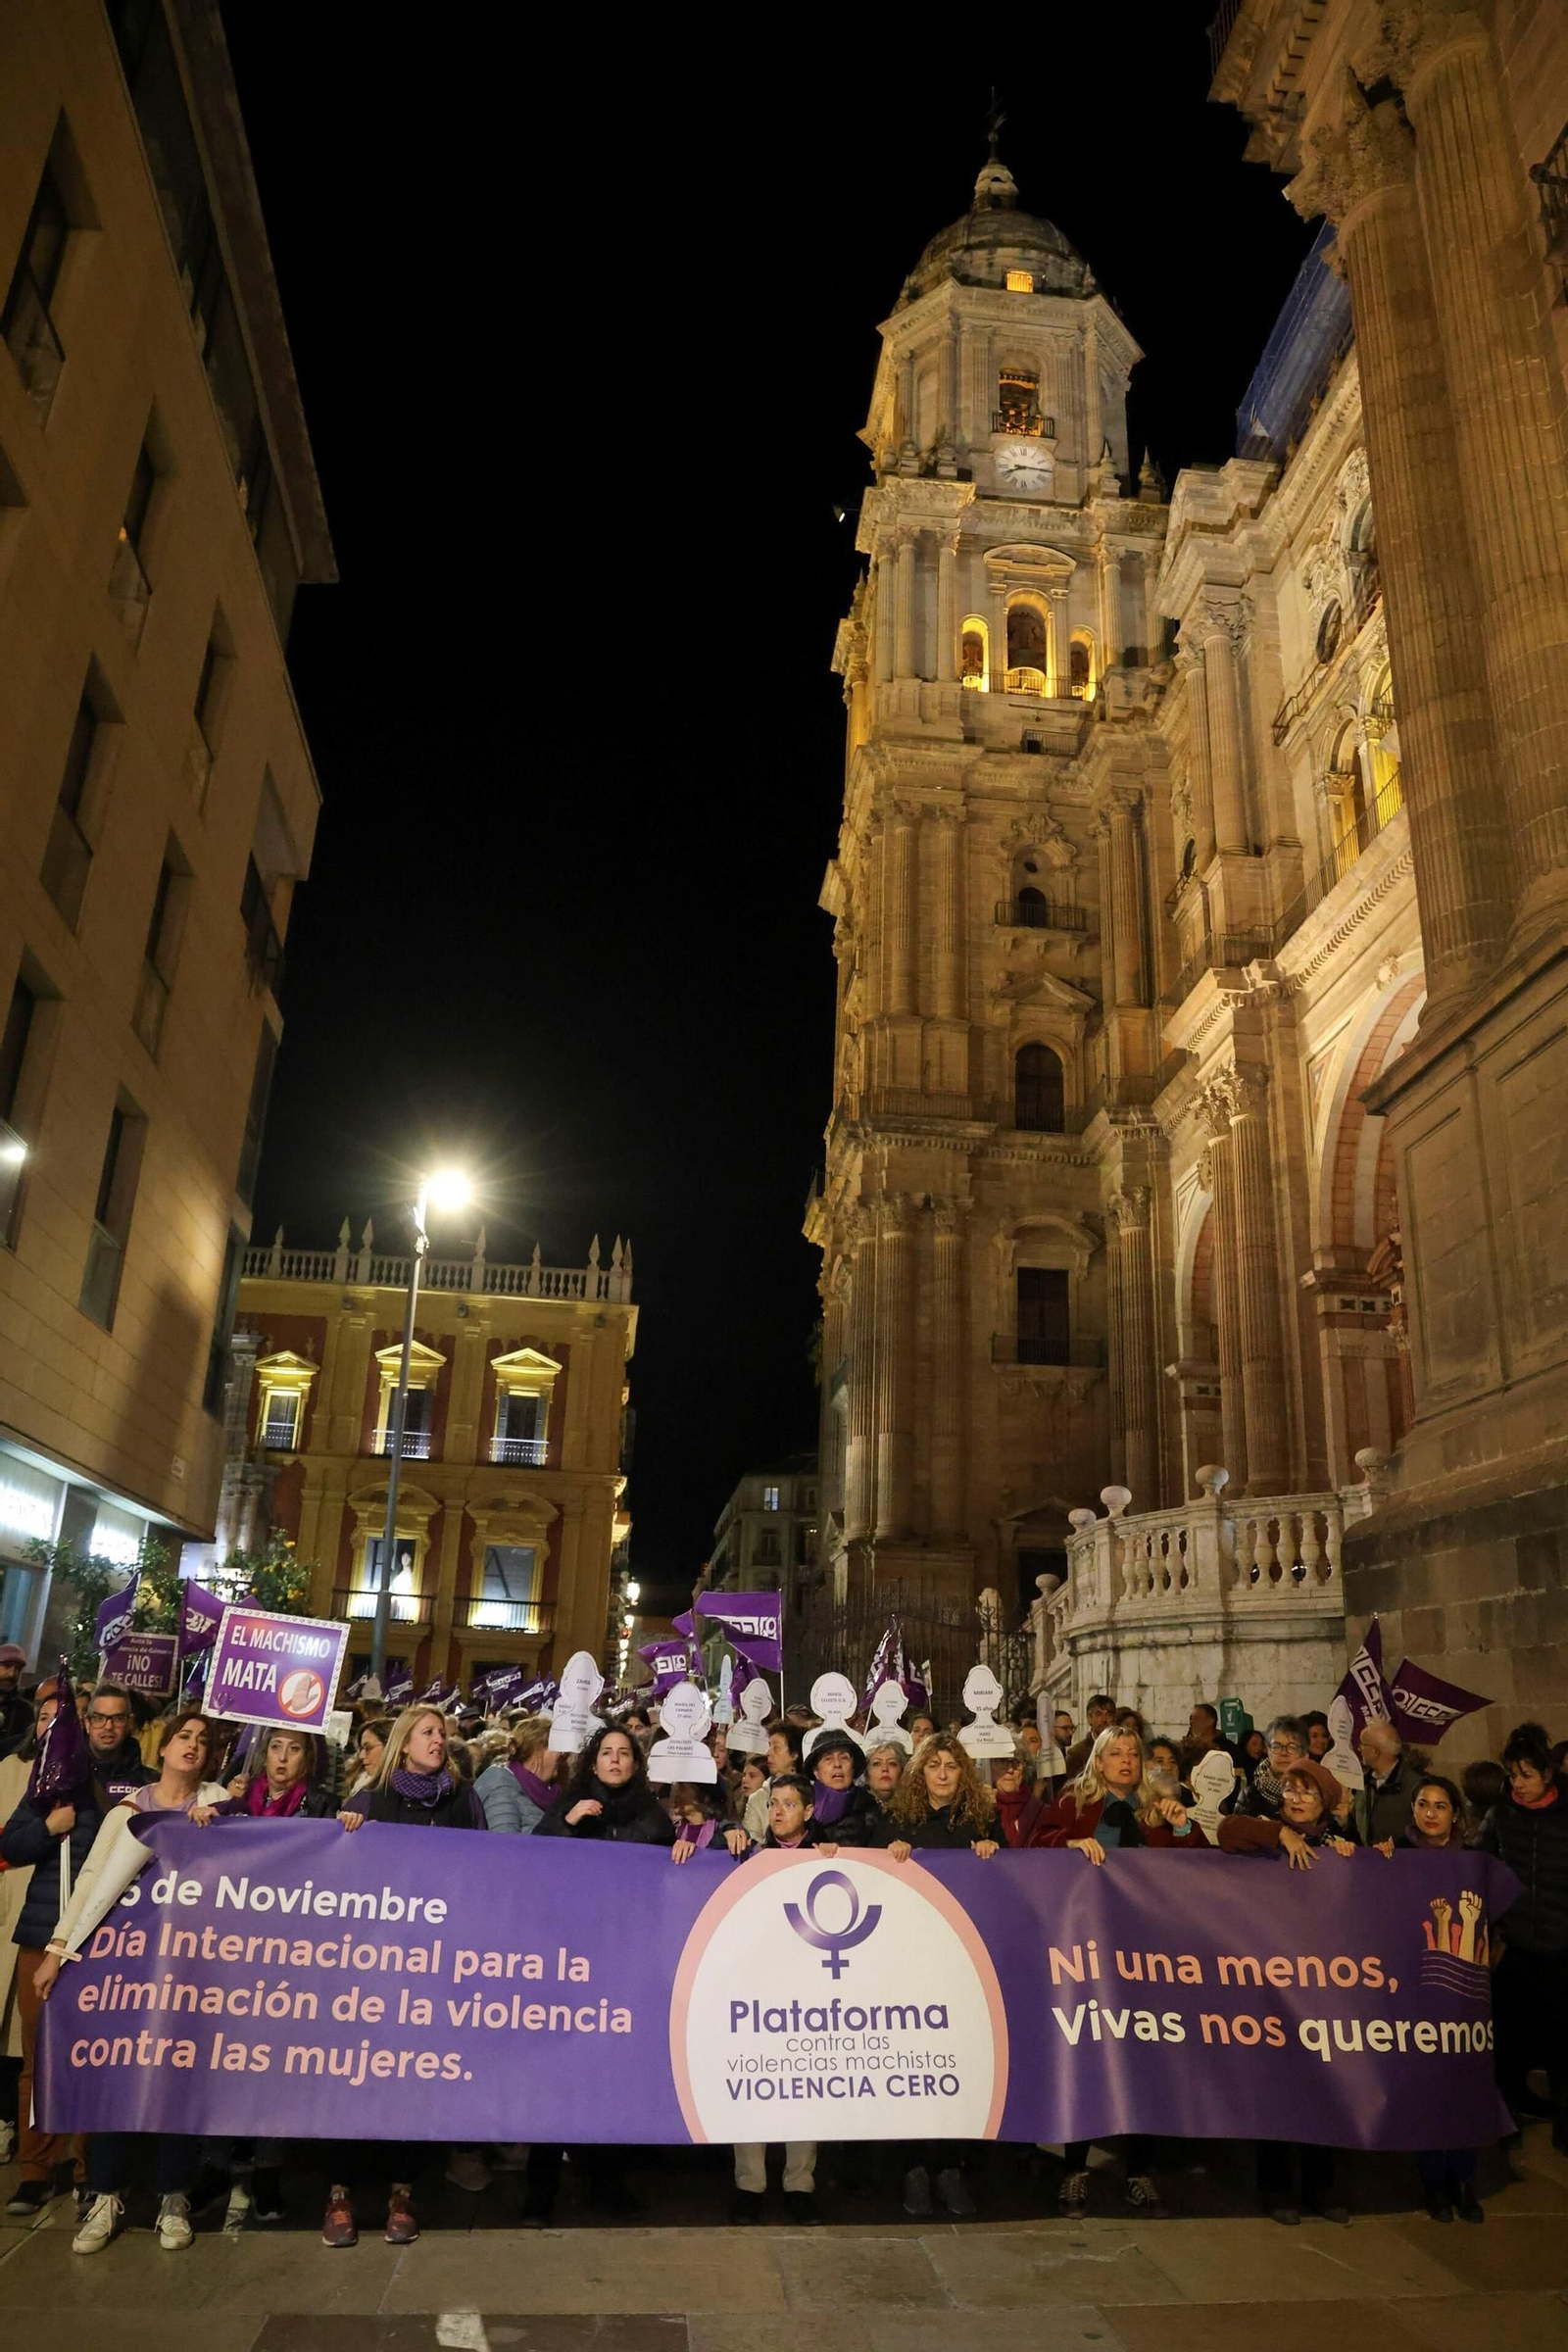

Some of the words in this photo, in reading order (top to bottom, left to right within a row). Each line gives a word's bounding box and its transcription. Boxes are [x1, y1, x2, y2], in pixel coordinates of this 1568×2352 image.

[230, 1625, 247, 1647] EL
[249, 1628, 331, 1659] MACHISMO
[221, 1657, 278, 1693] MATA
[151, 1871, 203, 1906] de
[215, 1875, 448, 1924] Noviembre
[89, 1922, 147, 1959] Día
[158, 1922, 442, 1975] Internacional
[453, 1950, 544, 1984] para
[558, 1946, 591, 1983] la
[1049, 1939, 1101, 1985] Ni
[1115, 1950, 1203, 1984] una
[1217, 1955, 1399, 1994] menos,
[77, 1973, 318, 2020] eliminación
[331, 1986, 385, 2023] de
[398, 1988, 433, 2026] la
[447, 1992, 632, 2034] violencia
[729, 1998, 950, 2034] Plataforma
[786, 2034, 856, 2053] contra
[862, 2033, 891, 2050] las
[1052, 1999, 1187, 2046] Vivas
[1200, 2013, 1287, 2047] nos
[1298, 2019, 1494, 2062] queremos
[71, 2030, 196, 2068] contra
[209, 2032, 271, 2073] las
[283, 2038, 472, 2087] mujeres.
[727, 2053, 838, 2073] violencias
[846, 2050, 957, 2071] machistas
[726, 2076, 876, 2101] VIOLENCIA
[886, 2074, 960, 2097] CERO
